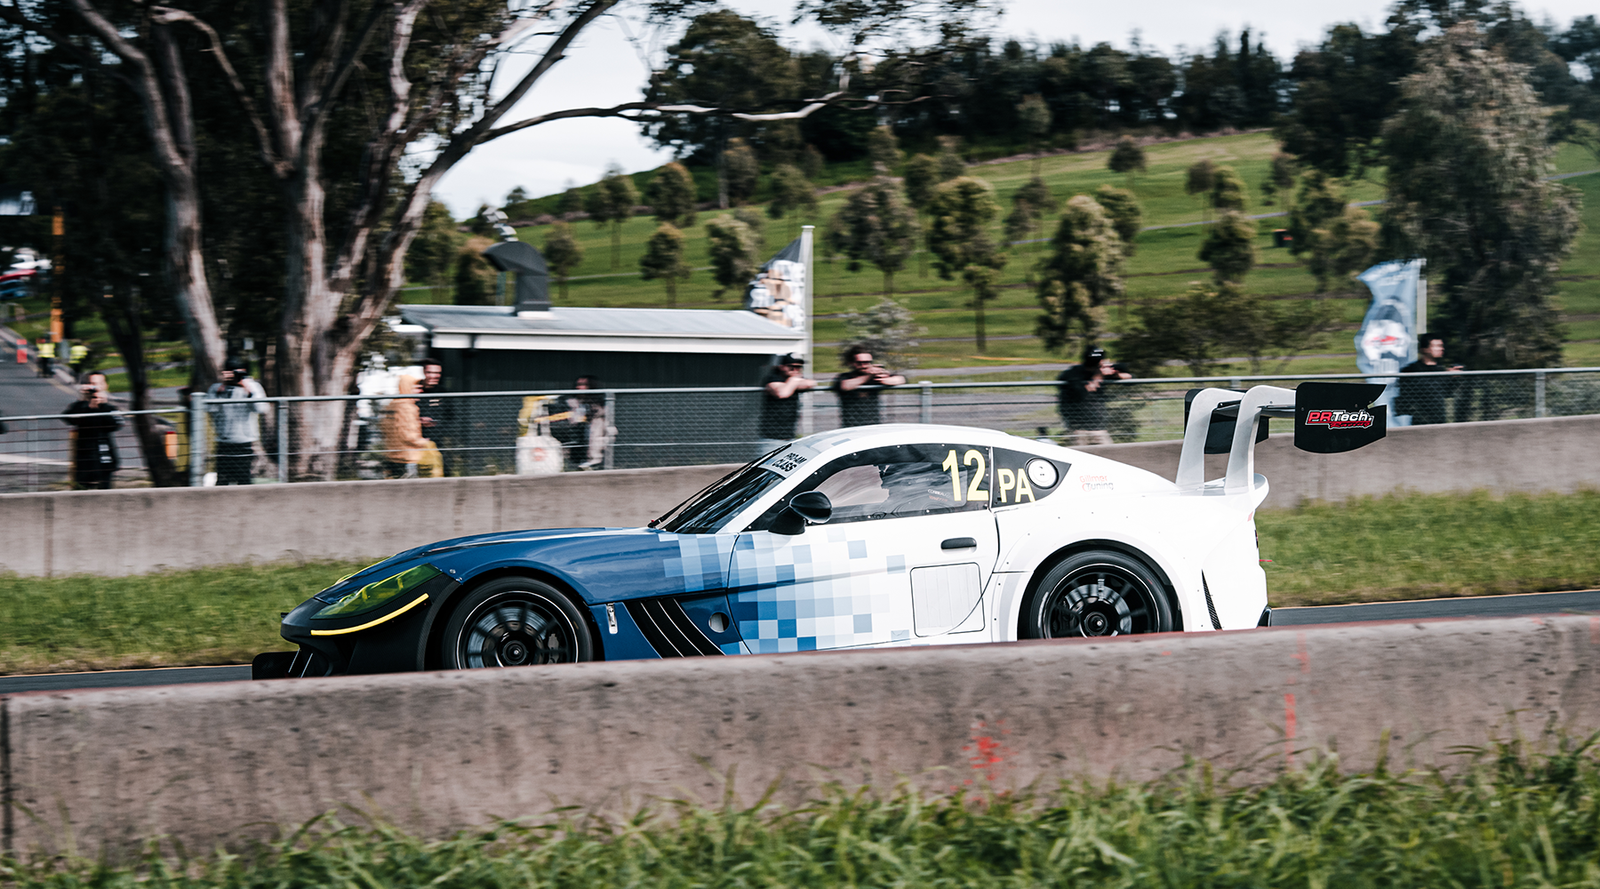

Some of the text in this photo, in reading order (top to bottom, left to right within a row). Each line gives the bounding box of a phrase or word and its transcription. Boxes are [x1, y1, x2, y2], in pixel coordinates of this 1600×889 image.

[772, 459, 797, 472] CLASS
[942, 449, 989, 501] 12
[997, 468, 1036, 503] PA
